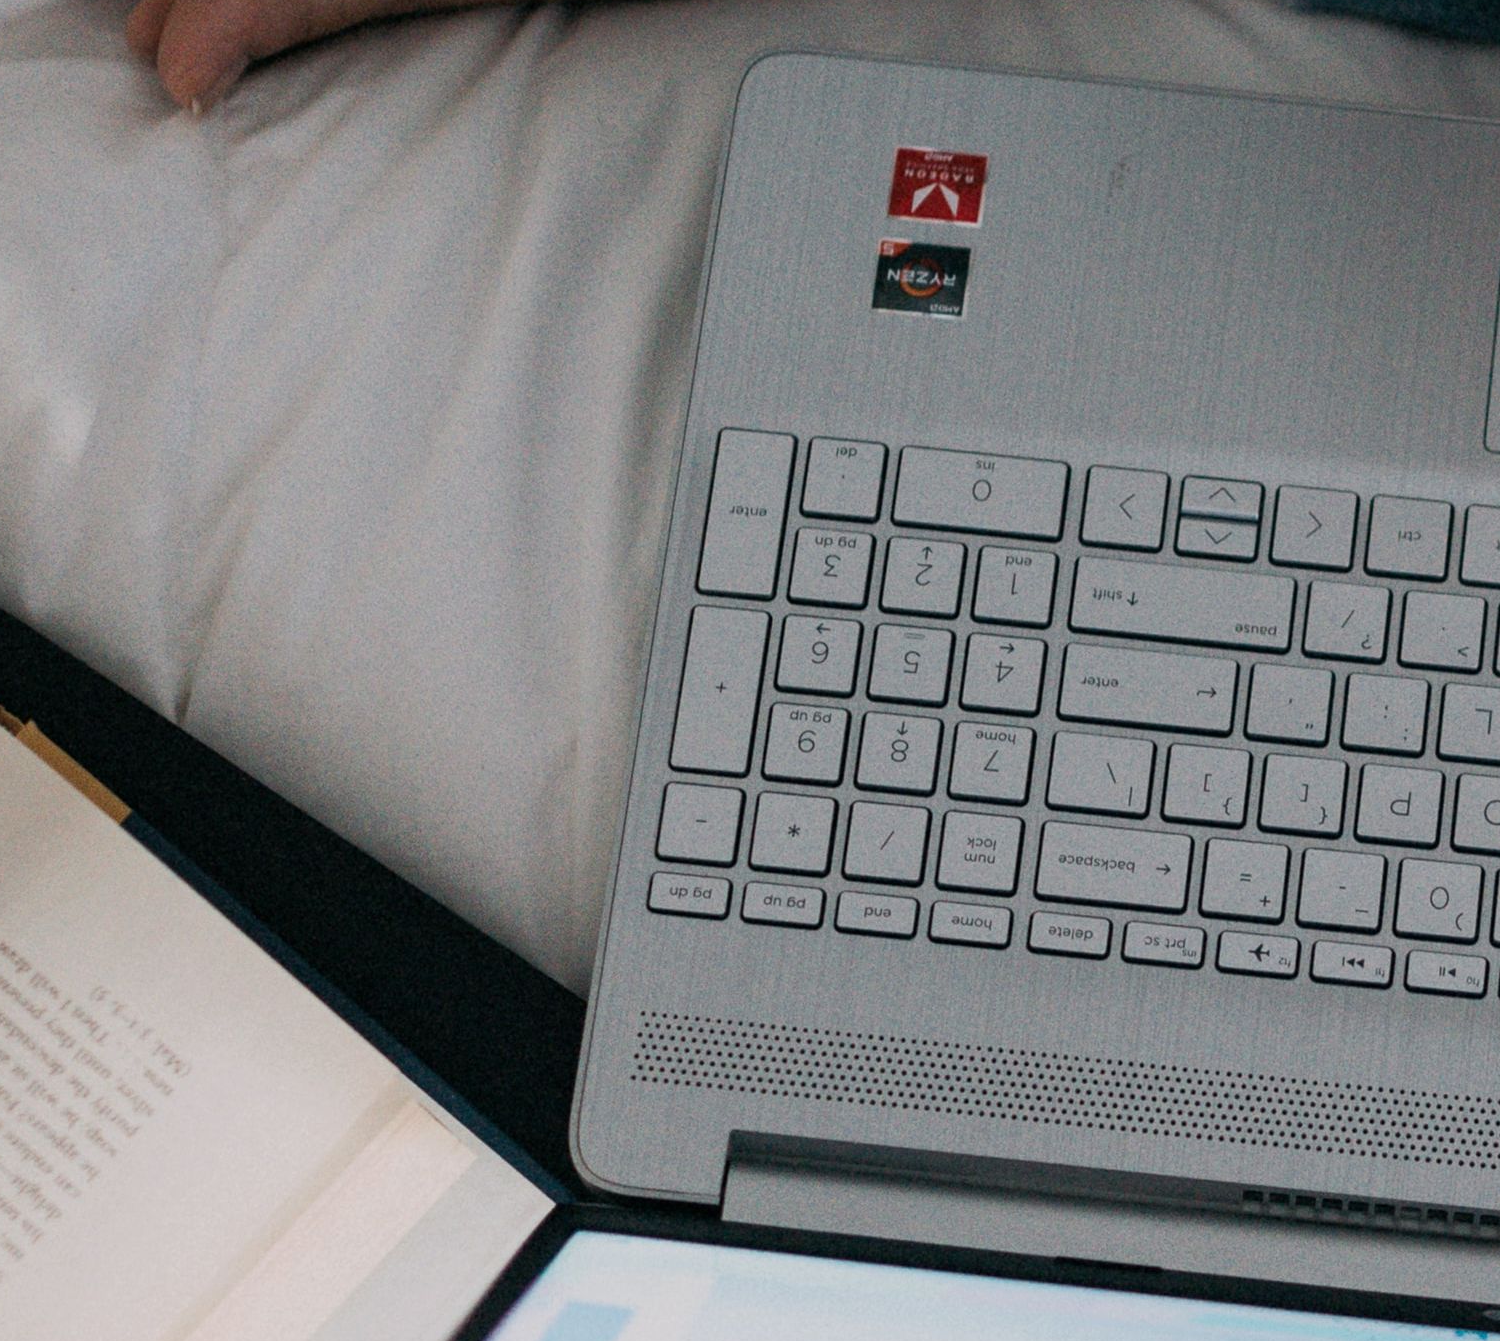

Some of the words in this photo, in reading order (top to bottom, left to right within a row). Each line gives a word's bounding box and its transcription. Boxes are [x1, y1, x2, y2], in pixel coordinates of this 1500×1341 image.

[903, 168, 974, 184] RADEON
[886, 267, 957, 286] RYZEN
[1078, 674, 1121, 690] enter
[1473, 706, 1495, 737] L
[1387, 789, 1414, 819] P
[965, 835, 999, 853] lock
[962, 851, 997, 866] num
[1056, 852, 1138, 876] backspace
[762, 894, 790, 908] up
[785, 895, 807, 910] pg
[862, 905, 893, 919] end
[950, 915, 994, 932] home
[1047, 925, 1095, 942] delete
